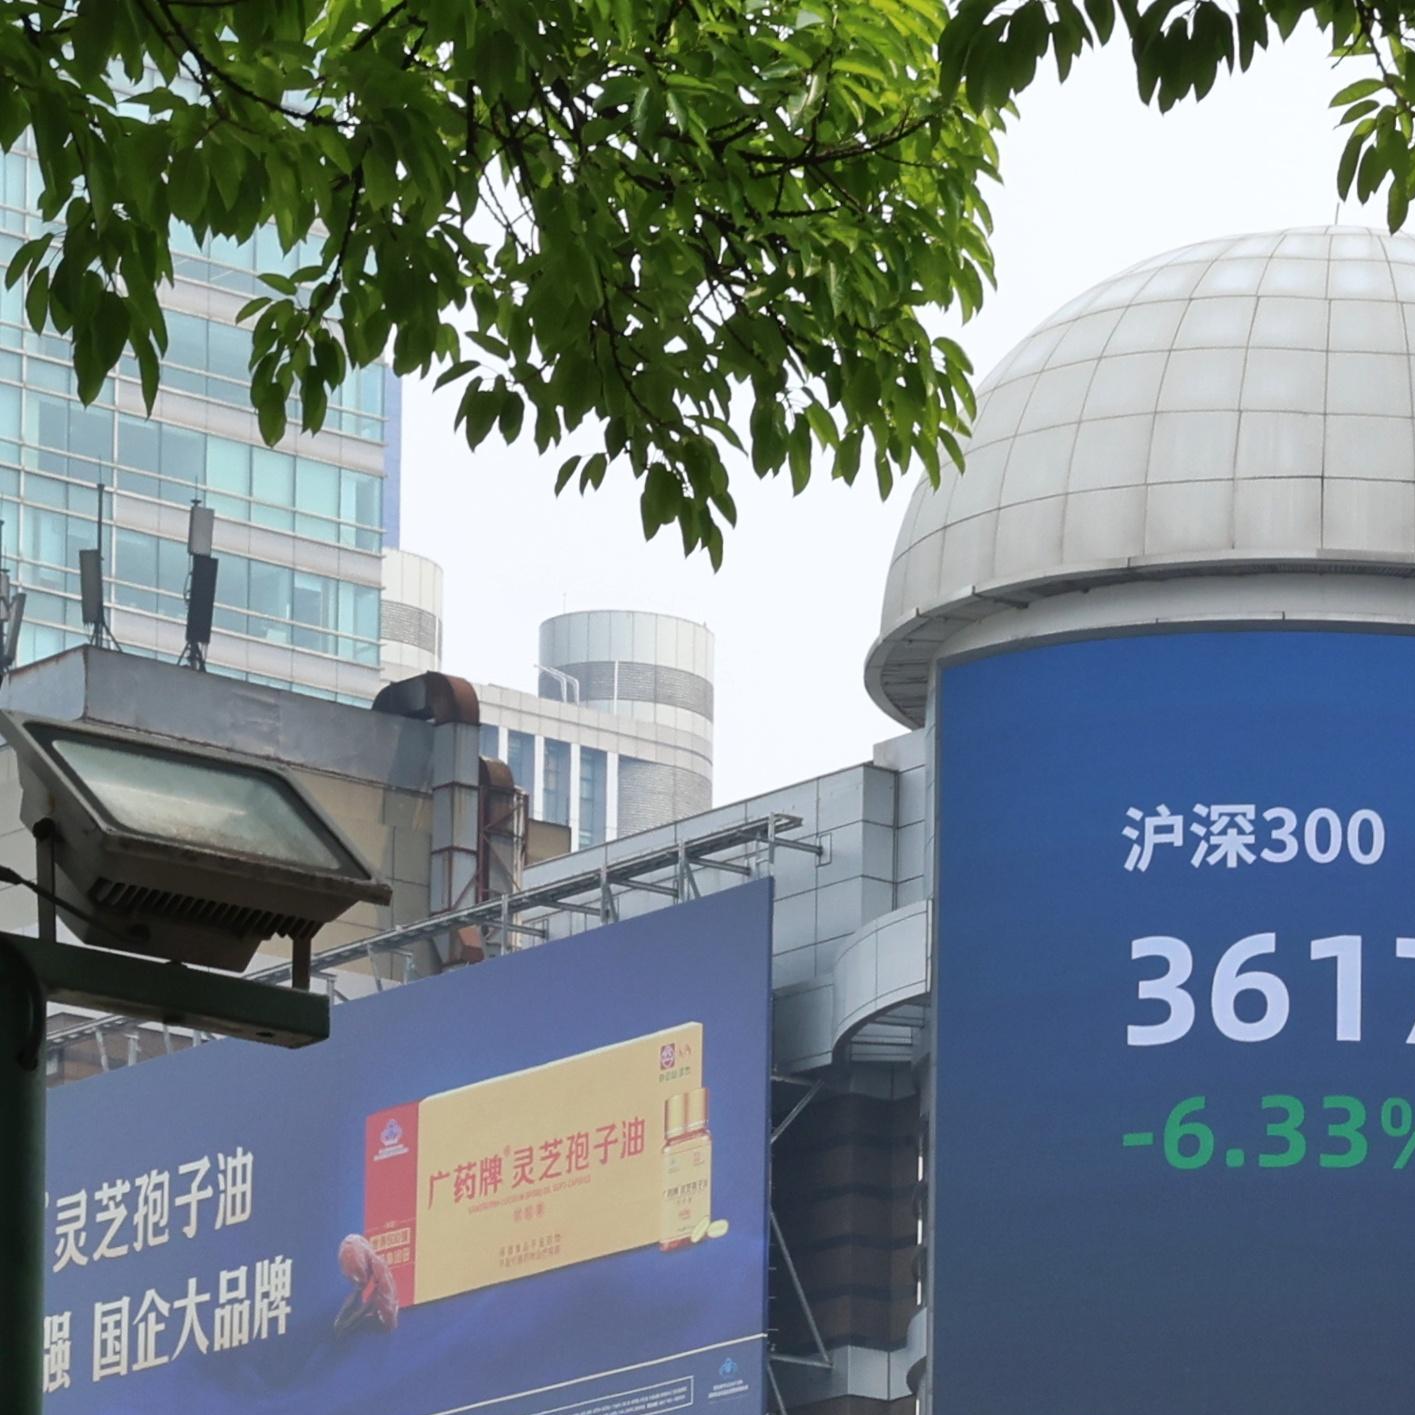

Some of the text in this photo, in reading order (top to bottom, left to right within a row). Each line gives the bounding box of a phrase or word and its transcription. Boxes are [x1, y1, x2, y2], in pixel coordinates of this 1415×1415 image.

[1121, 802, 1386, 872] 沪深300
[53, 1146, 254, 1273] 灵芝孢子油
[93, 1255, 292, 1382] 国企大品牌
